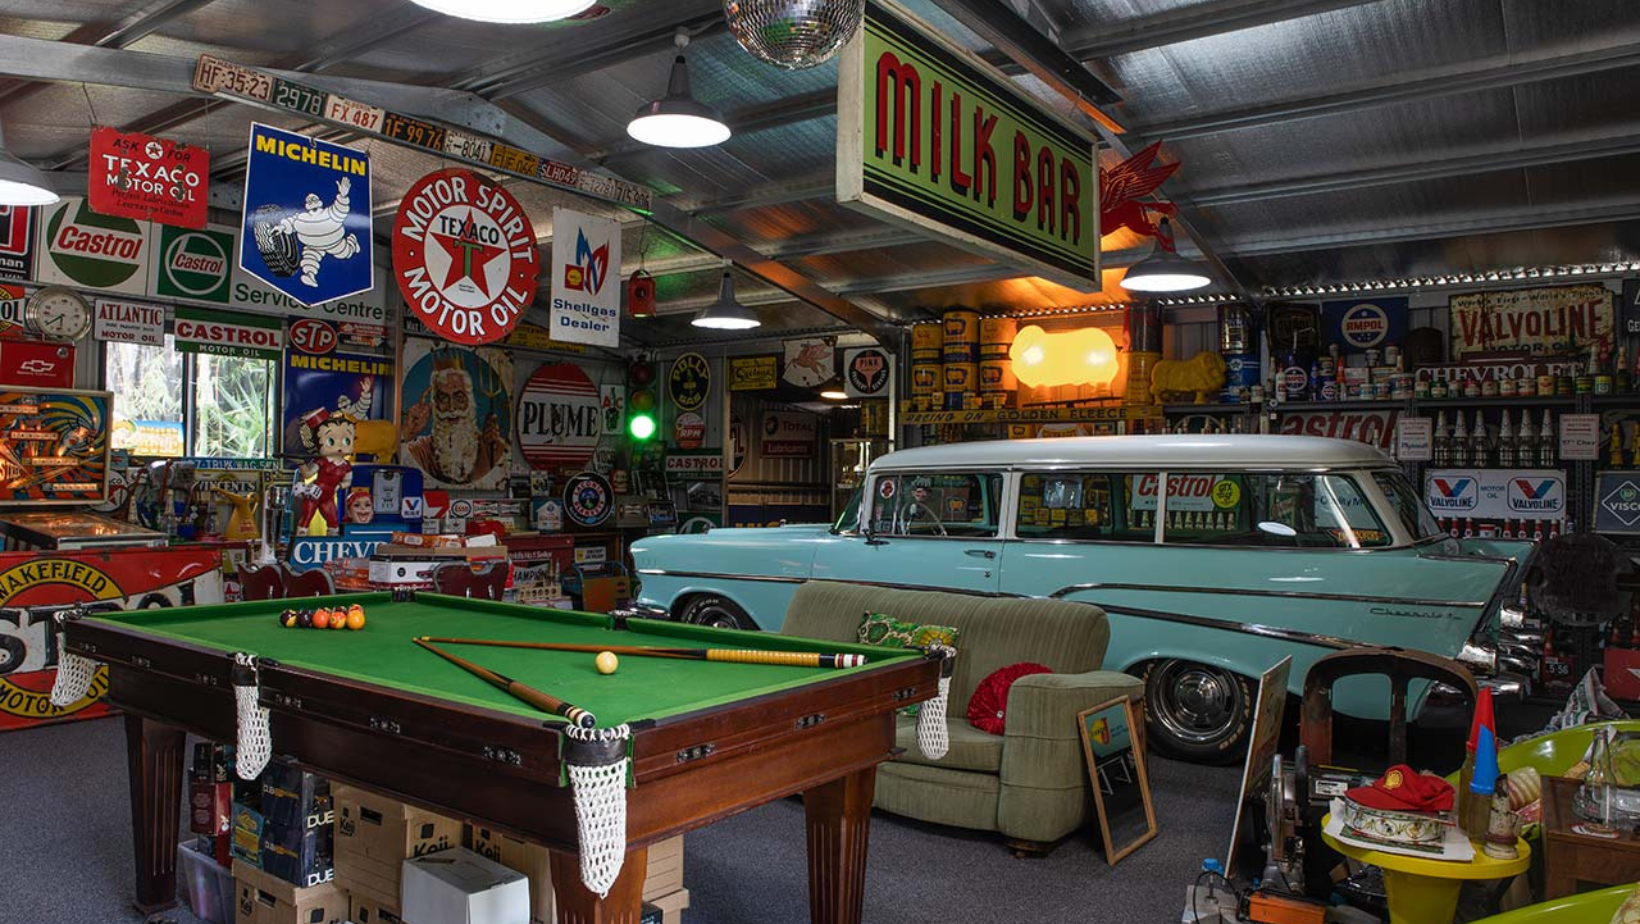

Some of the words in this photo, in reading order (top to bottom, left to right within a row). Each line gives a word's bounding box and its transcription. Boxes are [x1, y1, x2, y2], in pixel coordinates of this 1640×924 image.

[276, 85, 322, 115] 2978
[331, 103, 350, 122] FX
[353, 110, 379, 129] 487
[406, 125, 423, 146] 99
[112, 138, 140, 152] ASK
[166, 149, 192, 162] FOR
[255, 134, 366, 177] MICHELIN
[875, 51, 999, 210] MILK
[1013, 129, 1081, 246] BAR
[102, 153, 200, 187] TEXACO
[401, 176, 469, 243] MOTOR
[475, 184, 534, 265] SPIRIT
[438, 214, 500, 246] TEXACO
[57, 225, 144, 260] Castrol
[174, 252, 224, 274] Castrol
[462, 241, 483, 278] T
[403, 266, 486, 337] MOTOR
[490, 285, 528, 327] OIL
[553, 298, 617, 318] Shellgas
[98, 303, 163, 326] ATLANTIC
[559, 316, 610, 332] Dealer
[1459, 299, 1604, 347] VALVOLINE
[101, 330, 136, 342] MOTOR
[141, 332, 158, 343] OIL
[176, 322, 279, 347] CASTROL
[294, 322, 333, 349] STP
[199, 343, 236, 355] MOTOR
[242, 348, 261, 357] OIL
[672, 356, 708, 381] POLLY
[602, 395, 623, 409] AC
[522, 400, 599, 438] PLUME
[782, 421, 814, 432] TOTAL
[964, 411, 985, 422] ON
[997, 409, 1059, 421] GOLDEN
[1069, 408, 1128, 420] FLEECE
[1480, 485, 1506, 493] MOTOR
[1486, 491, 1499, 499] OIL
[1430, 496, 1474, 508] VALVOLINE
[1512, 497, 1559, 509] VALVOLINE
[306, 810, 334, 829] DUE
[307, 868, 334, 887] DUE
